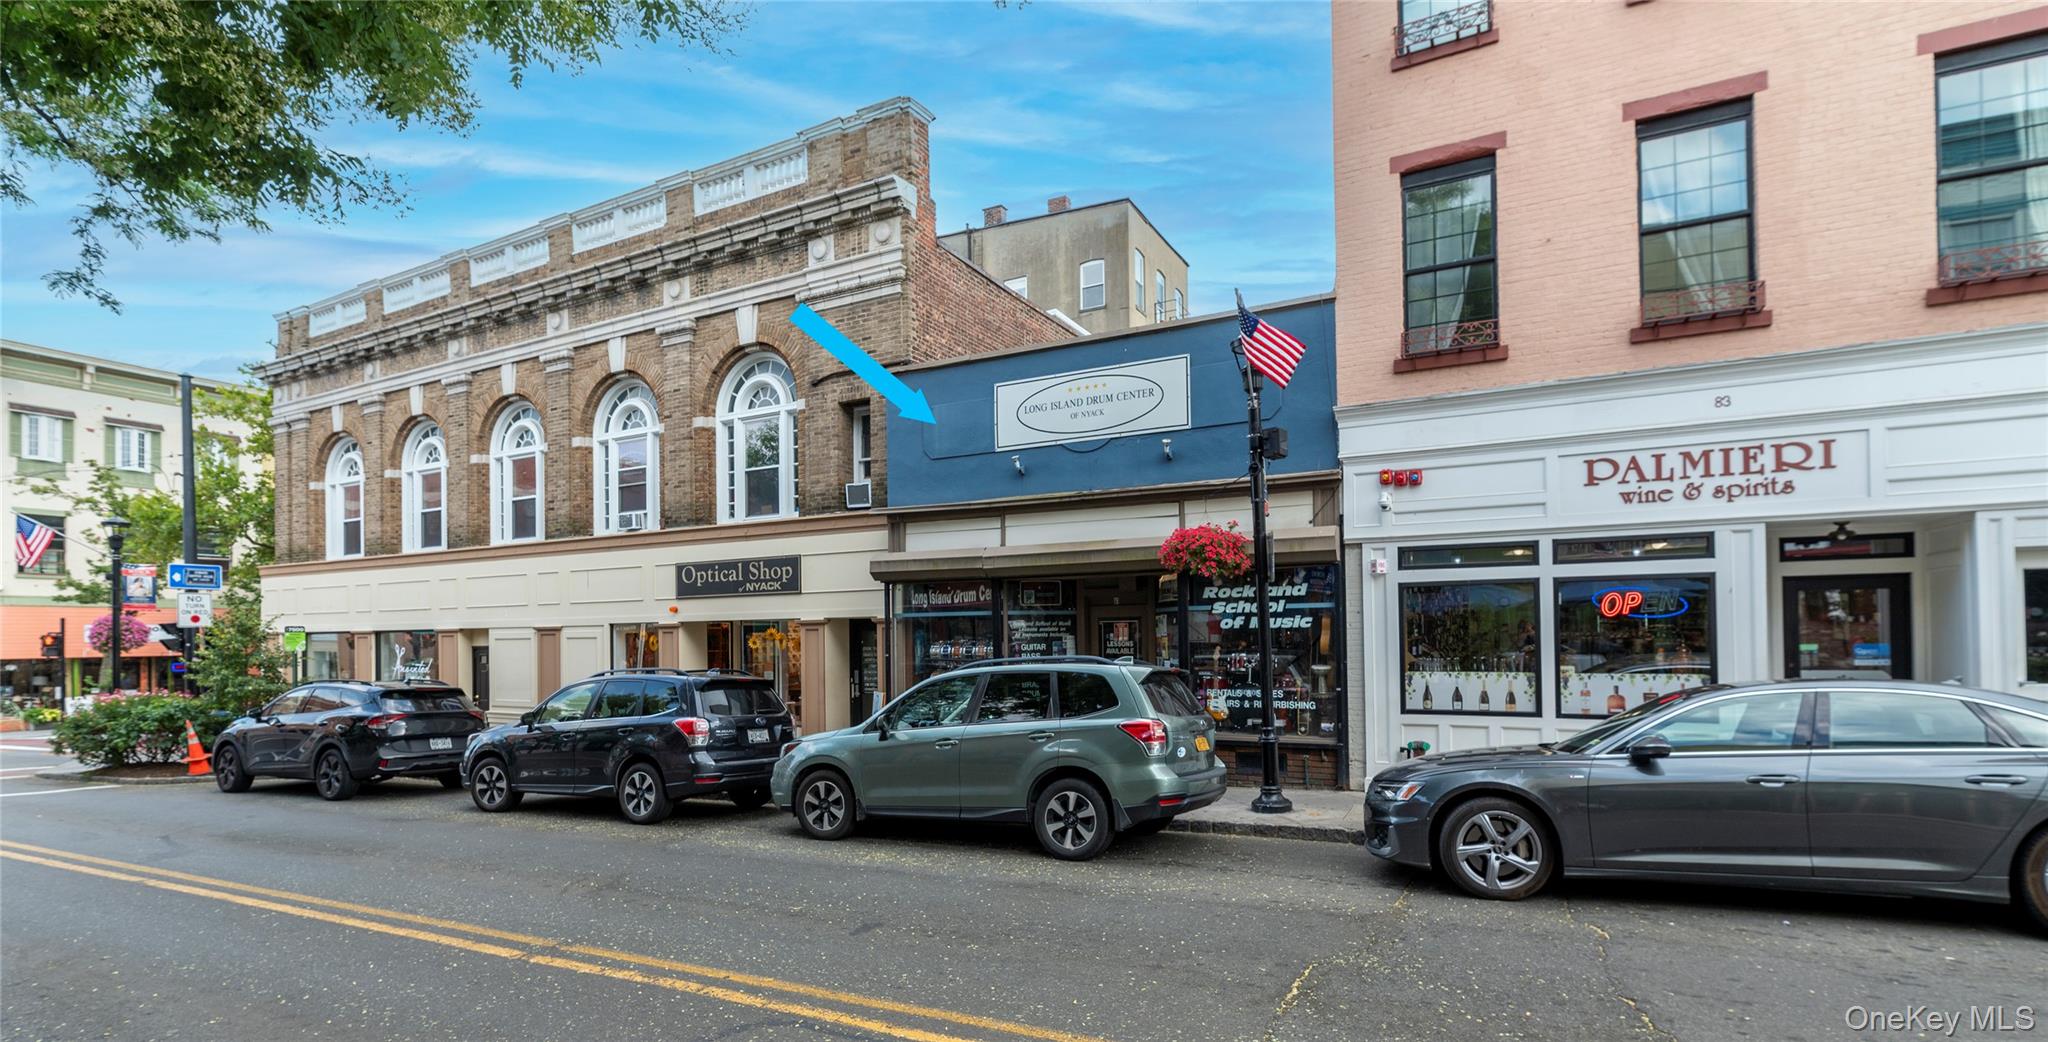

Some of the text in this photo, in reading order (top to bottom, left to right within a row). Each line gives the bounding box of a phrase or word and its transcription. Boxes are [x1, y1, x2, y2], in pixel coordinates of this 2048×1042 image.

[1024, 388, 1156, 415] LONG ISLAND DRUM CENTER
[1714, 395, 1732, 408] 83
[1070, 409, 1105, 420] OF NYACK
[1583, 439, 1838, 487] PALMIERI
[1619, 477, 1796, 505] wine & spirits
[682, 561, 793, 587] Optical Shop
[746, 582, 782, 592] NYACK
[1202, 583, 1309, 599] Rockand
[911, 588, 928, 608] Long
[1601, 588, 1680, 617] OPEN
[1220, 615, 1245, 629] of
[1021, 643, 1047, 651] GUITAR
[1206, 689, 1242, 698] RENTALS
[1257, 689, 1284, 698] SES
[1244, 700, 1250, 708] &
